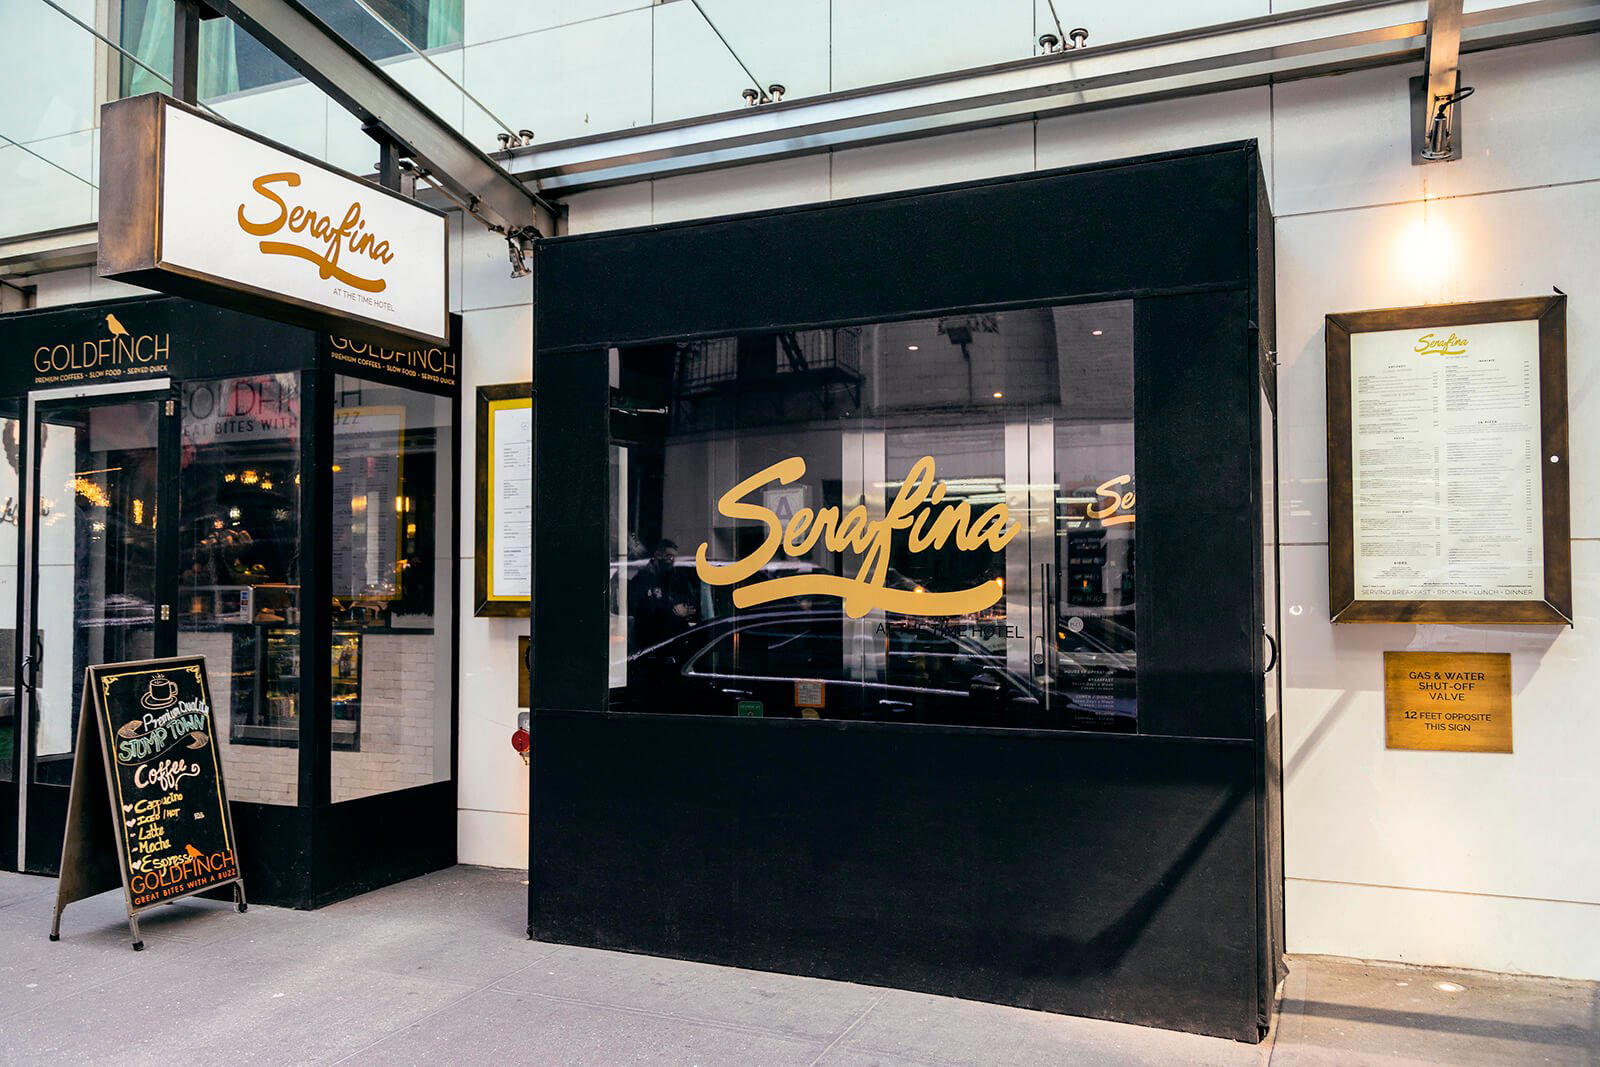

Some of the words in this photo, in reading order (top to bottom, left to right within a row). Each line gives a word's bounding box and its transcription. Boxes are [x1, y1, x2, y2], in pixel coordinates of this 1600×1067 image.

[237, 172, 395, 293] Serafina
[333, 288, 343, 296] AT
[343, 290, 357, 302] THE
[358, 294, 373, 306] TIME
[373, 300, 395, 312] HOTEL
[34, 333, 170, 372] GOLDFINCH
[1414, 332, 1469, 356] Serafina
[35, 375, 60, 383] PREMIUM
[60, 372, 84, 382] COFFEES
[89, 370, 104, 379] SLOW
[105, 368, 122, 377] FOOD
[127, 366, 149, 375] SERVED
[149, 364, 169, 373] QUICK
[331, 352, 357, 363] PREMIUM
[357, 357, 381, 369] COFFEES
[386, 365, 401, 373] SLOW
[402, 368, 417, 377] FOOD
[421, 372, 439, 383] SERVED
[440, 377, 456, 386] QUICK
[214, 419, 254, 435] BITES
[260, 417, 297, 431] WITH
[695, 455, 1021, 619] Serafina
[1361, 588, 1391, 596] SERVING
[1437, 588, 1468, 596] BRUNCH
[1473, 588, 1499, 596] LUNCH
[1505, 588, 1533, 596] DINNER
[933, 624, 967, 638] TIME
[972, 625, 1025, 639] HOTEL
[1409, 671, 1431, 680] GAS
[1434, 671, 1441, 680] &
[1444, 671, 1485, 681] WATER
[1418, 681, 1475, 691] SHUT-OFF
[1429, 692, 1465, 701] VALVE
[166, 714, 205, 740] TOWN
[1404, 711, 1417, 719] 12
[1419, 712, 1442, 720] FEET
[1444, 712, 1492, 722] OPPOSITE
[1424, 722, 1446, 731] THIS
[1448, 723, 1471, 732] SIGN
[134, 759, 200, 791] Coffee
[138, 823, 165, 840] Latte
[139, 837, 171, 853] Mocha
[131, 848, 235, 894] GOLDFINCH
[140, 854, 194, 877] Espresso
[134, 892, 160, 905] GREAT
[163, 885, 185, 897] BITES
[187, 877, 207, 889] WITH
[218, 868, 237, 880] BUZZ
